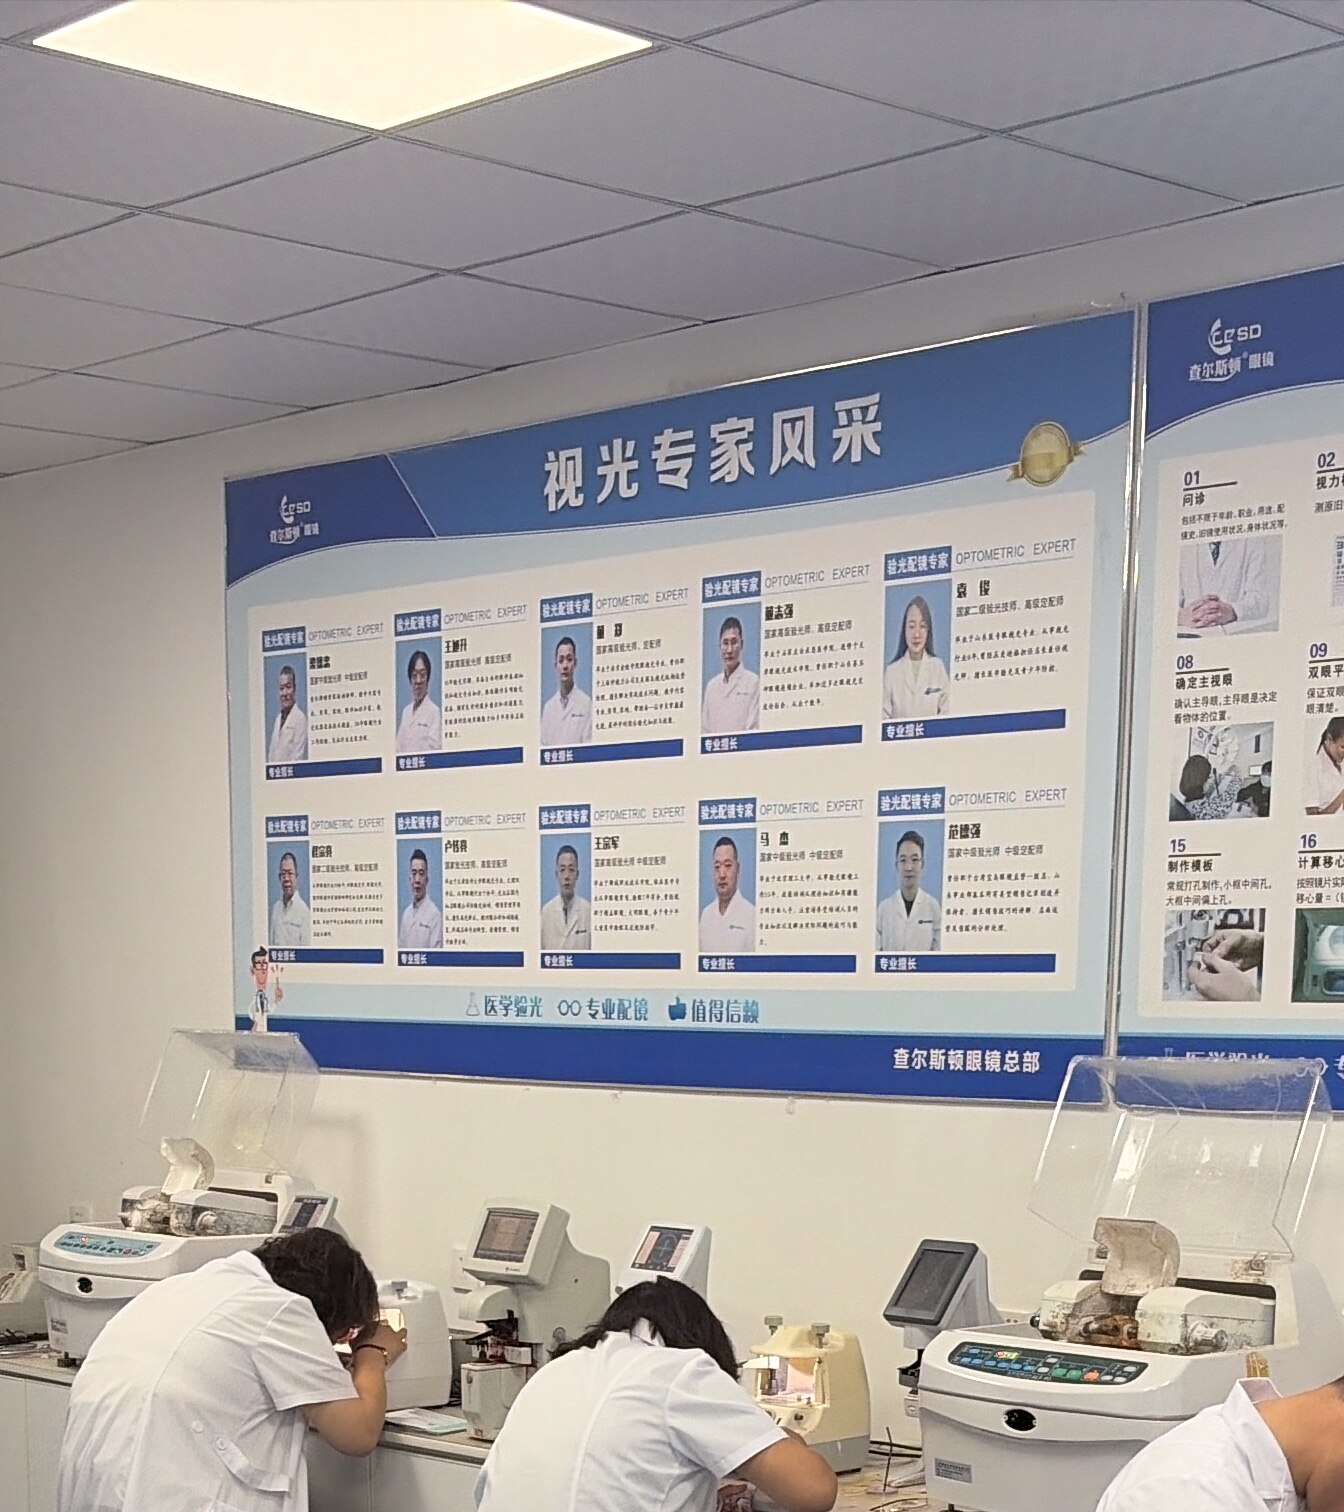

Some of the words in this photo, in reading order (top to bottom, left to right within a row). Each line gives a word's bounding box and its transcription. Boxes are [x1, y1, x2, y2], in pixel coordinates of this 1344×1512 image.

[544, 392, 883, 512] 视光专家风采
[1317, 452, 1336, 468] 02
[1184, 471, 1201, 486] 01
[1182, 491, 1206, 508] 问诊
[955, 545, 1025, 565] OPTOMETRIC
[1033, 538, 1076, 556] EXPERT
[764, 571, 825, 588] OPTOMETRIC
[832, 564, 870, 580] EXPERT
[596, 593, 649, 610] OPTOMETRIC
[655, 588, 689, 602] EXPERT
[444, 609, 492, 625] OPTOMETRIC
[497, 604, 528, 618] EXPERT
[309, 626, 352, 642] OPTOMETRIC
[357, 622, 384, 636] EXPERT
[1309, 643, 1327, 658] 09
[1176, 655, 1194, 670] 08
[1175, 673, 1233, 690] 确定主视眼
[949, 790, 1016, 806] OPTOMETRIC
[1025, 788, 1067, 802] EXPERT
[594, 808, 646, 821] OPTOMETRIC
[652, 806, 686, 818] EXPERT
[760, 801, 819, 816] OPTOMETRIC
[826, 799, 864, 812] EXPERT
[311, 818, 354, 831] OPTOMETRIC
[358, 817, 385, 829] EXPERT
[444, 814, 492, 827] OPTOMETRIC
[497, 812, 528, 824] EXPERT
[1170, 839, 1186, 853] 15
[1300, 834, 1317, 849] 16
[1167, 857, 1214, 873] 制作模板
[484, 995, 543, 1018] 医学验光
[587, 996, 649, 1021] 专业配镜
[691, 998, 760, 1023] 值得信赖
[892, 1047, 1041, 1074] 查尔斯顿眼镜总部
